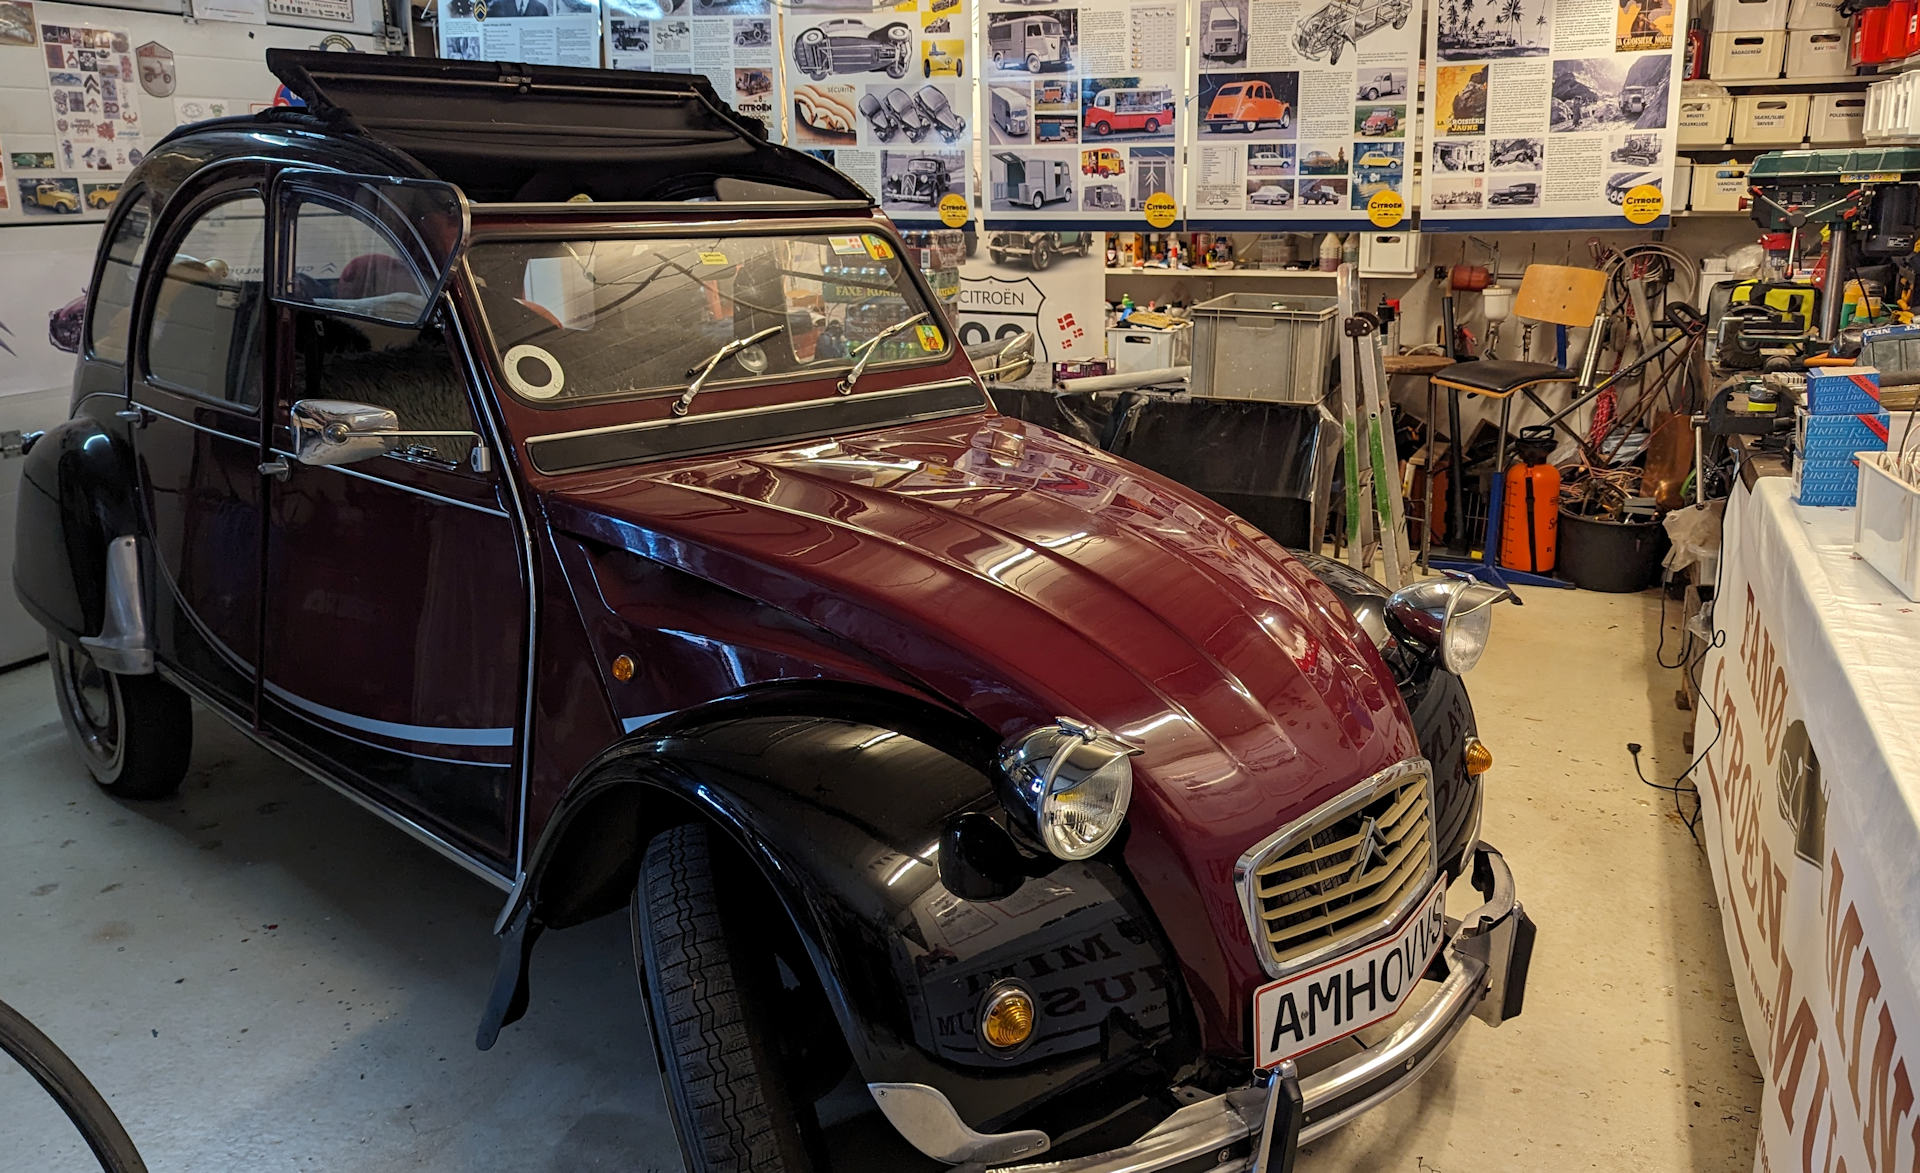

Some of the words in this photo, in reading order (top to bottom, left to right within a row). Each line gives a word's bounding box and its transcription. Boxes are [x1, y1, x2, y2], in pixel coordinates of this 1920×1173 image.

[1451, 124, 1479, 132] JAUNE
[835, 286, 863, 297] FAXE
[960, 288, 1025, 306] CITROËN
[1740, 581, 1789, 766] FANØ
